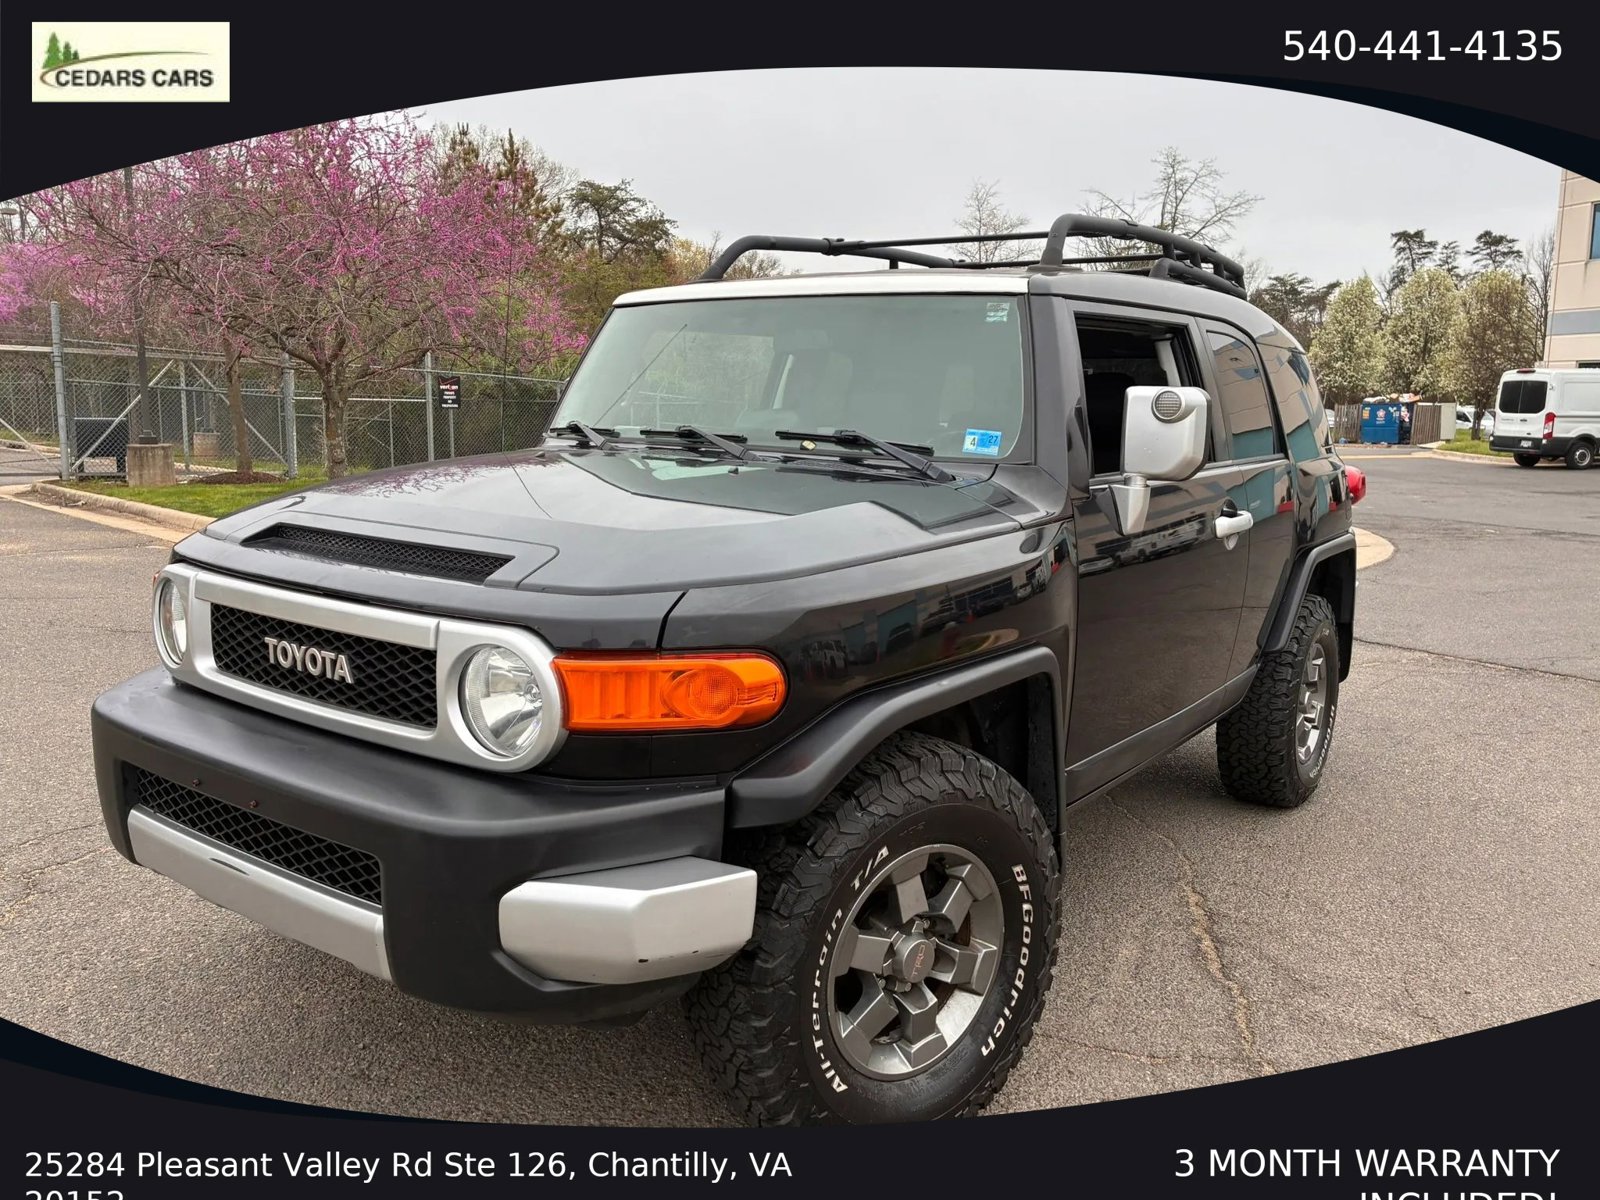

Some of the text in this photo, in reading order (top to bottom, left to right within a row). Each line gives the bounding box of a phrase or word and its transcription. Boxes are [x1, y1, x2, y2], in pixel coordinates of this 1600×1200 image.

[988, 435, 999, 444] 27
[264, 637, 354, 684] TOYOTA
[812, 845, 889, 1094] All-Terrain T/A
[981, 864, 1034, 1057] BFGoodrich
